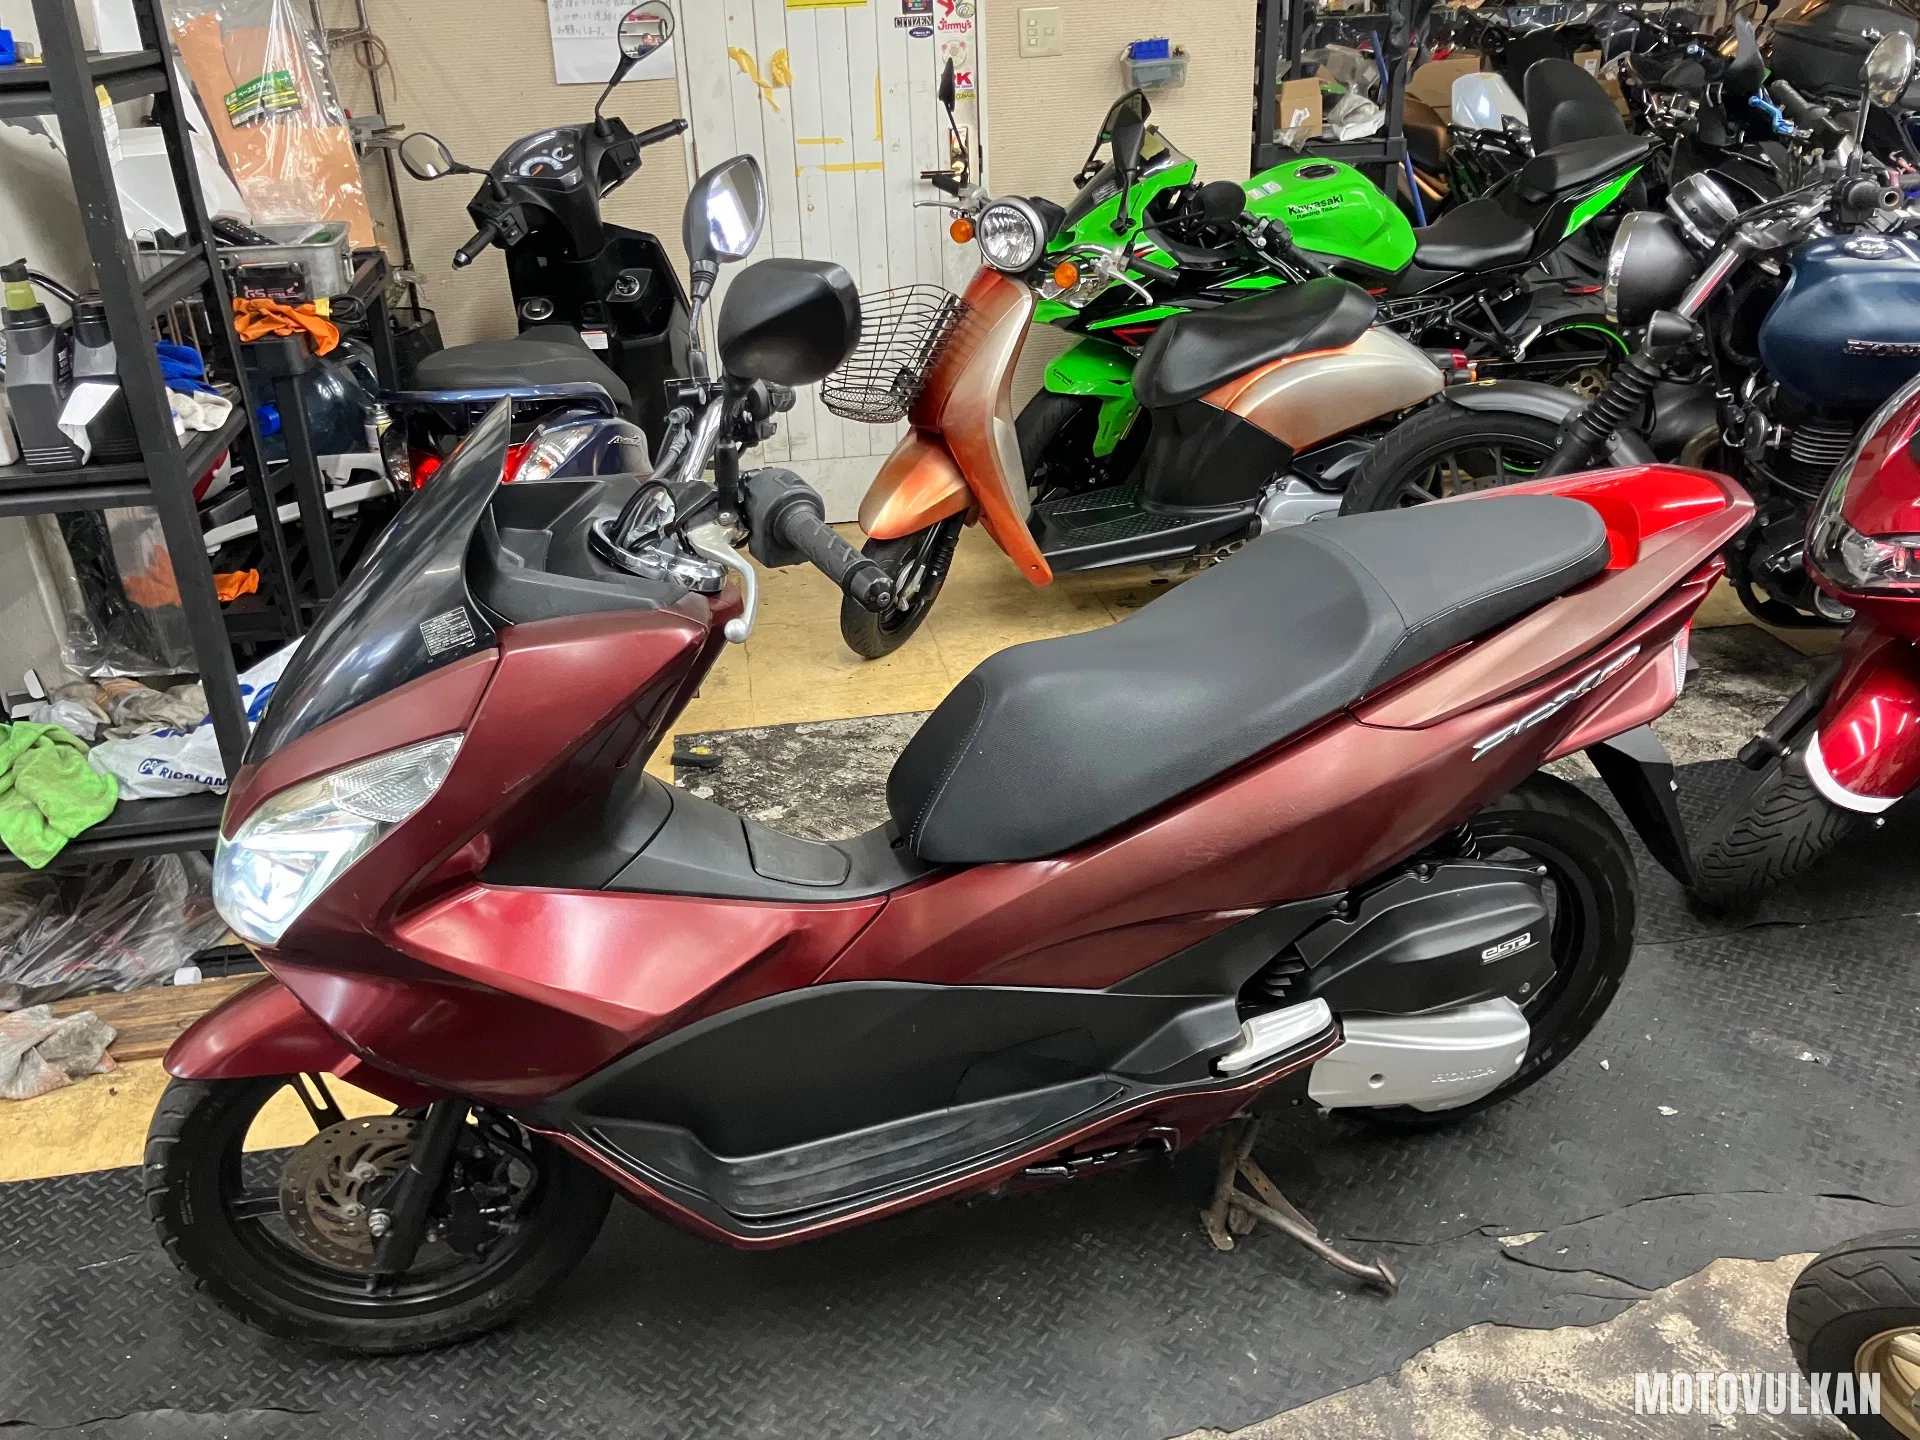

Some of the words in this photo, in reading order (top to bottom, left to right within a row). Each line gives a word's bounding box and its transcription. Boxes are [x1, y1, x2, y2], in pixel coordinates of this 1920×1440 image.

[895, 15, 933, 28] CITIZEN
[937, 18, 972, 33] Jimmy's
[1288, 194, 1344, 215] Kawasaki
